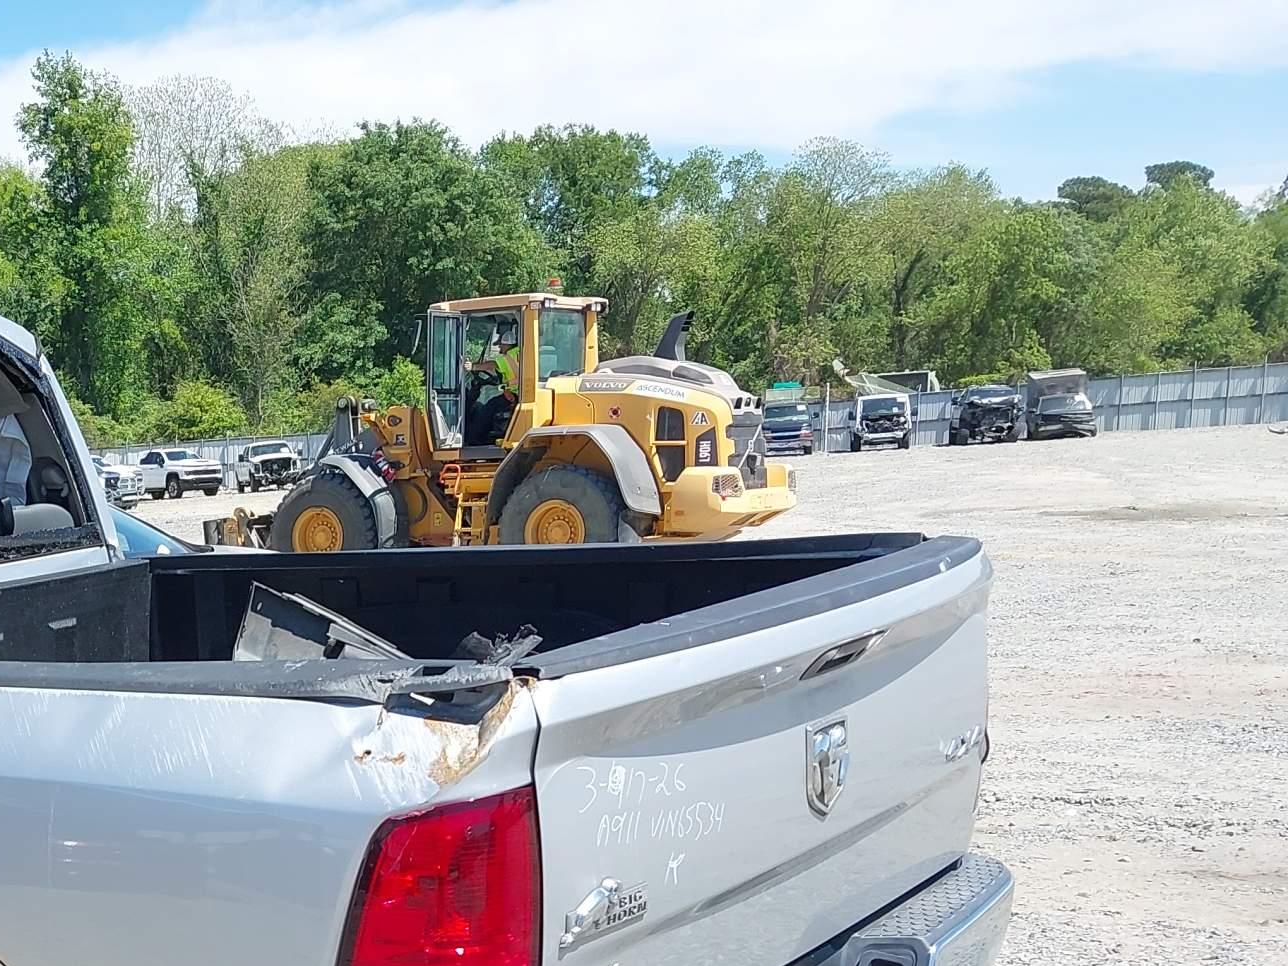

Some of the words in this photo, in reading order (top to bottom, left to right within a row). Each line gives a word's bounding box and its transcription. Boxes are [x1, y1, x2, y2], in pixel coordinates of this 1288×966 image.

[583, 381, 627, 390] VOLVO
[635, 384, 686, 399] ASCENDUM
[698, 440, 713, 463] L90H
[618, 890, 643, 909] BIG
[606, 901, 647, 926] HORN
